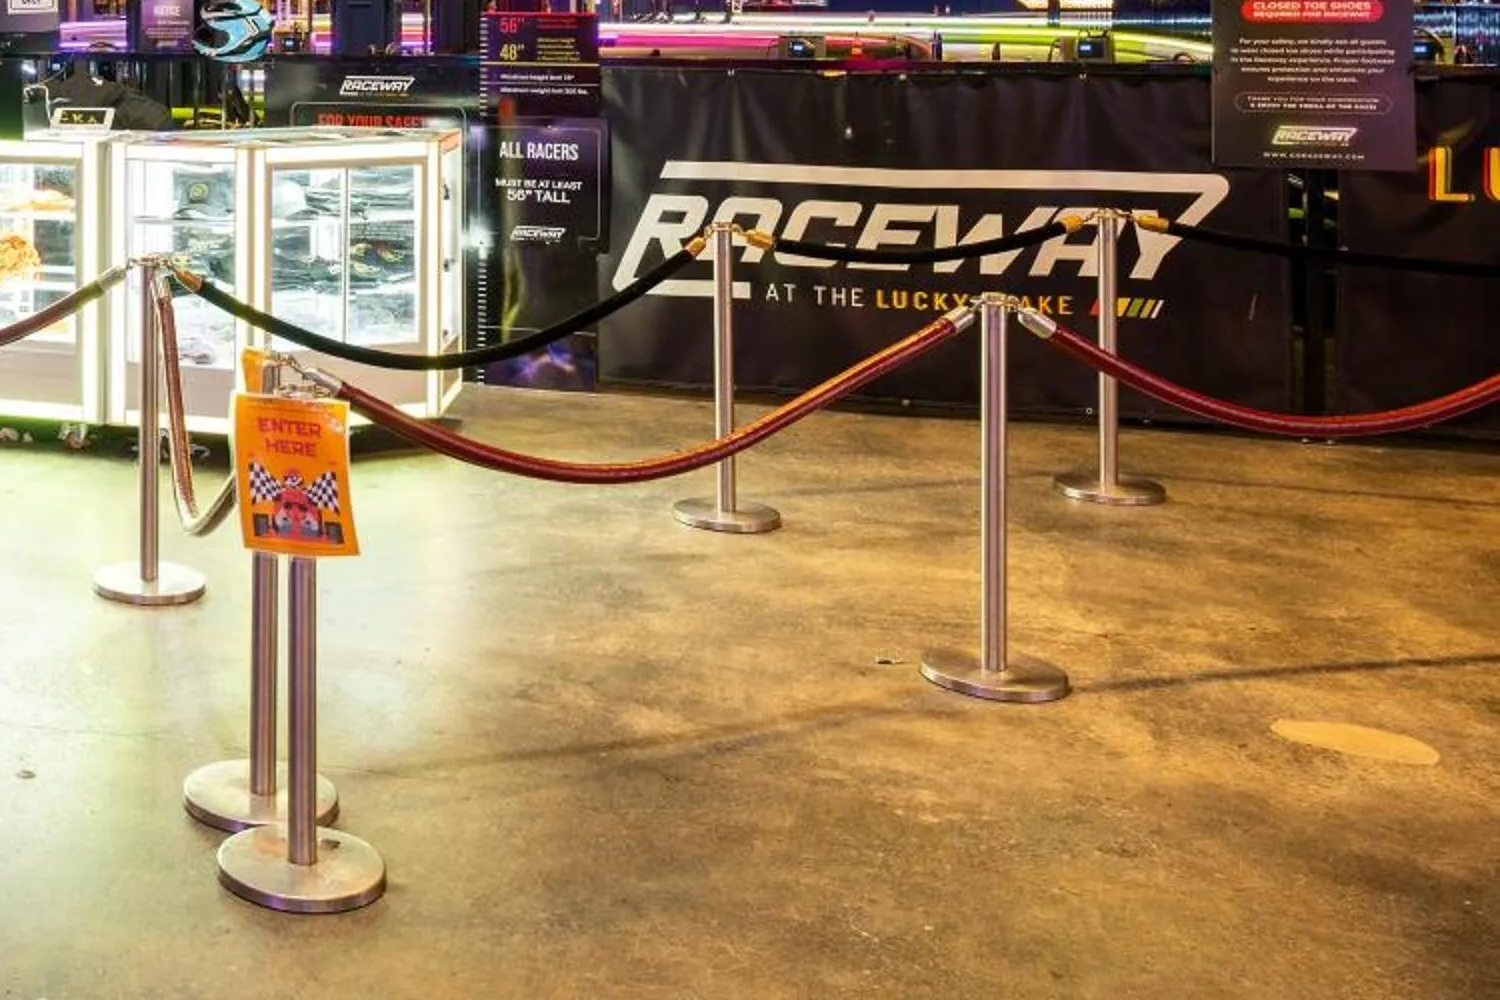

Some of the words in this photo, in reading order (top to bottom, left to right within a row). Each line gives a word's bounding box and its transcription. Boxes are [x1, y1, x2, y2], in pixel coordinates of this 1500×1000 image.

[1252, 1, 1301, 10] CLOSED
[1303, 1, 1328, 10] TOE
[1330, 1, 1371, 10] SHOES
[342, 79, 411, 92] RACEWAY
[318, 112, 344, 127] FOR
[348, 113, 383, 128] YOUR
[1275, 130, 1352, 142] RACEWAY
[499, 141, 524, 159] ALL
[527, 141, 579, 161] RACERS
[495, 178, 522, 188] MUST
[524, 179, 537, 188] BE
[538, 180, 550, 189] AT
[552, 181, 582, 191] LEAST
[535, 190, 571, 204] TALL
[622, 191, 1214, 281] RACEWAY
[765, 283, 797, 302] AT
[813, 285, 864, 307] THE
[875, 288, 970, 312] LUCKY
[257, 417, 321, 439] ENTER
[264, 438, 318, 457] HERE
